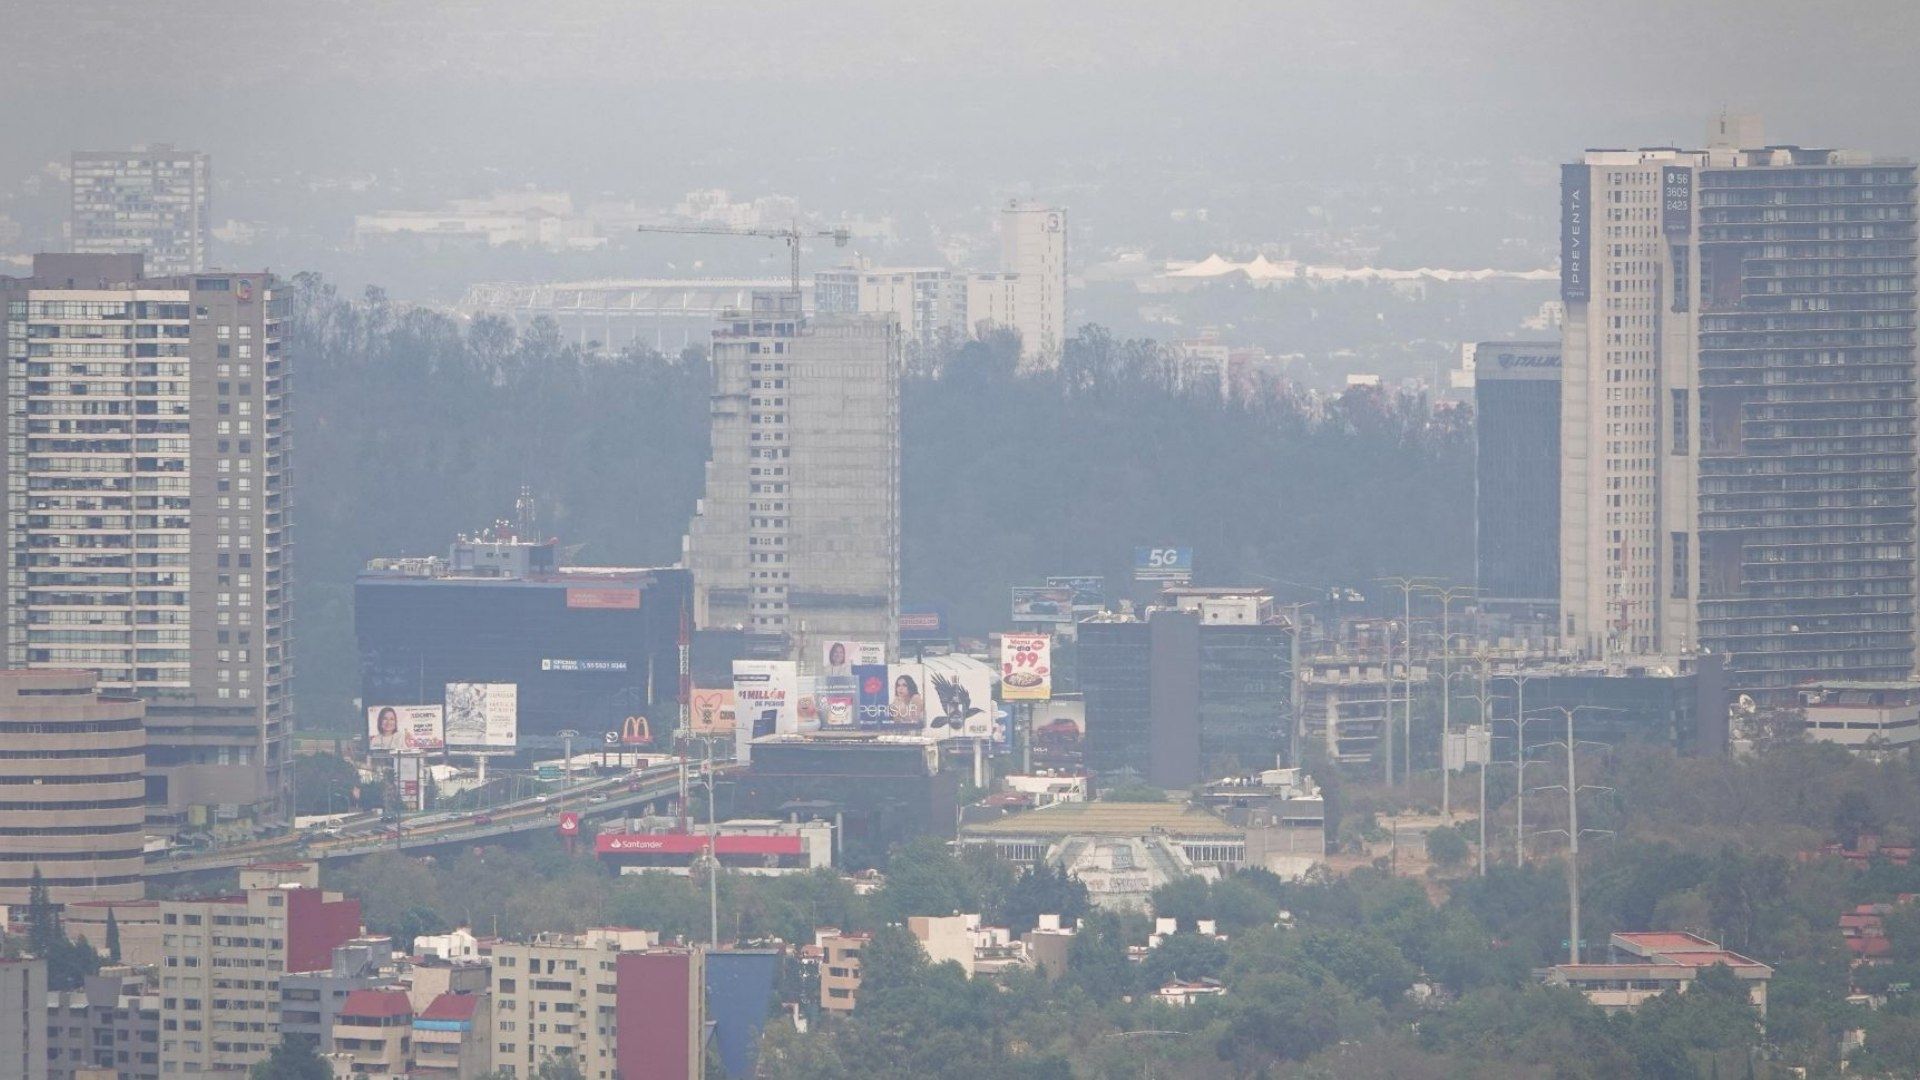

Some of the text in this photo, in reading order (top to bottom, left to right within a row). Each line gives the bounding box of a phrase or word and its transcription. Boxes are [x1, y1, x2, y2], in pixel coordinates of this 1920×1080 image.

[1676, 173, 1689, 184] 56
[1666, 187, 1689, 198] 3609
[1666, 200, 1689, 211] 2423
[1571, 189, 1581, 284] PREVENTA
[1149, 549, 1178, 566] 5G
[622, 840, 663, 849] Santander
